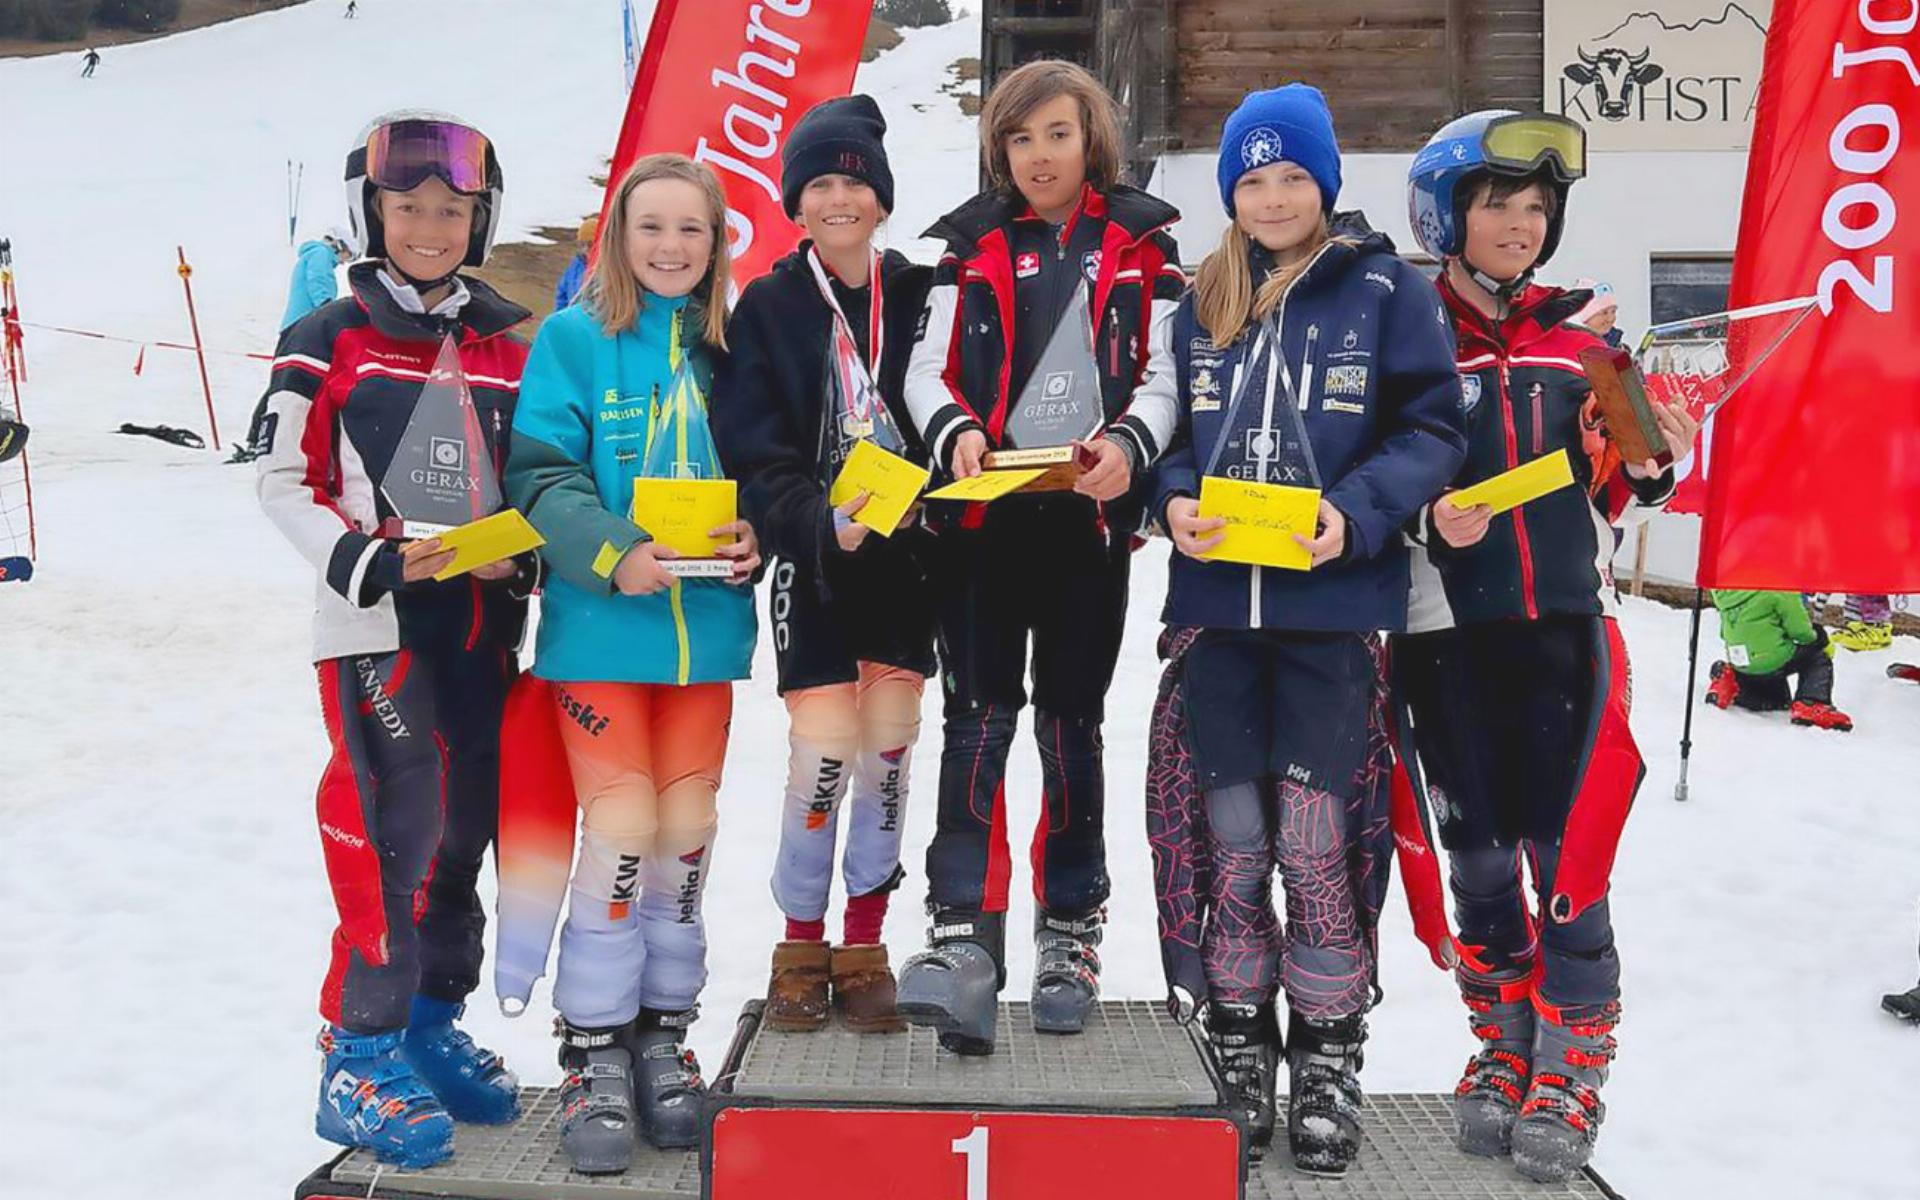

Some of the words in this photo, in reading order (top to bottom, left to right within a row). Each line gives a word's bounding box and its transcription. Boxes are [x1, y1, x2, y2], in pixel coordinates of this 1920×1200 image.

[1559, 77, 1763, 122] KHST
[1817, 104, 1900, 317] 200
[1024, 400, 1080, 418] GERAX
[410, 468, 481, 492] GERAX
[1226, 464, 1297, 482] GEAX
[355, 656, 411, 740] ENNEDY
[1286, 762, 1312, 783] HH
[611, 853, 641, 903] KW
[951, 1126, 989, 1200] 1
